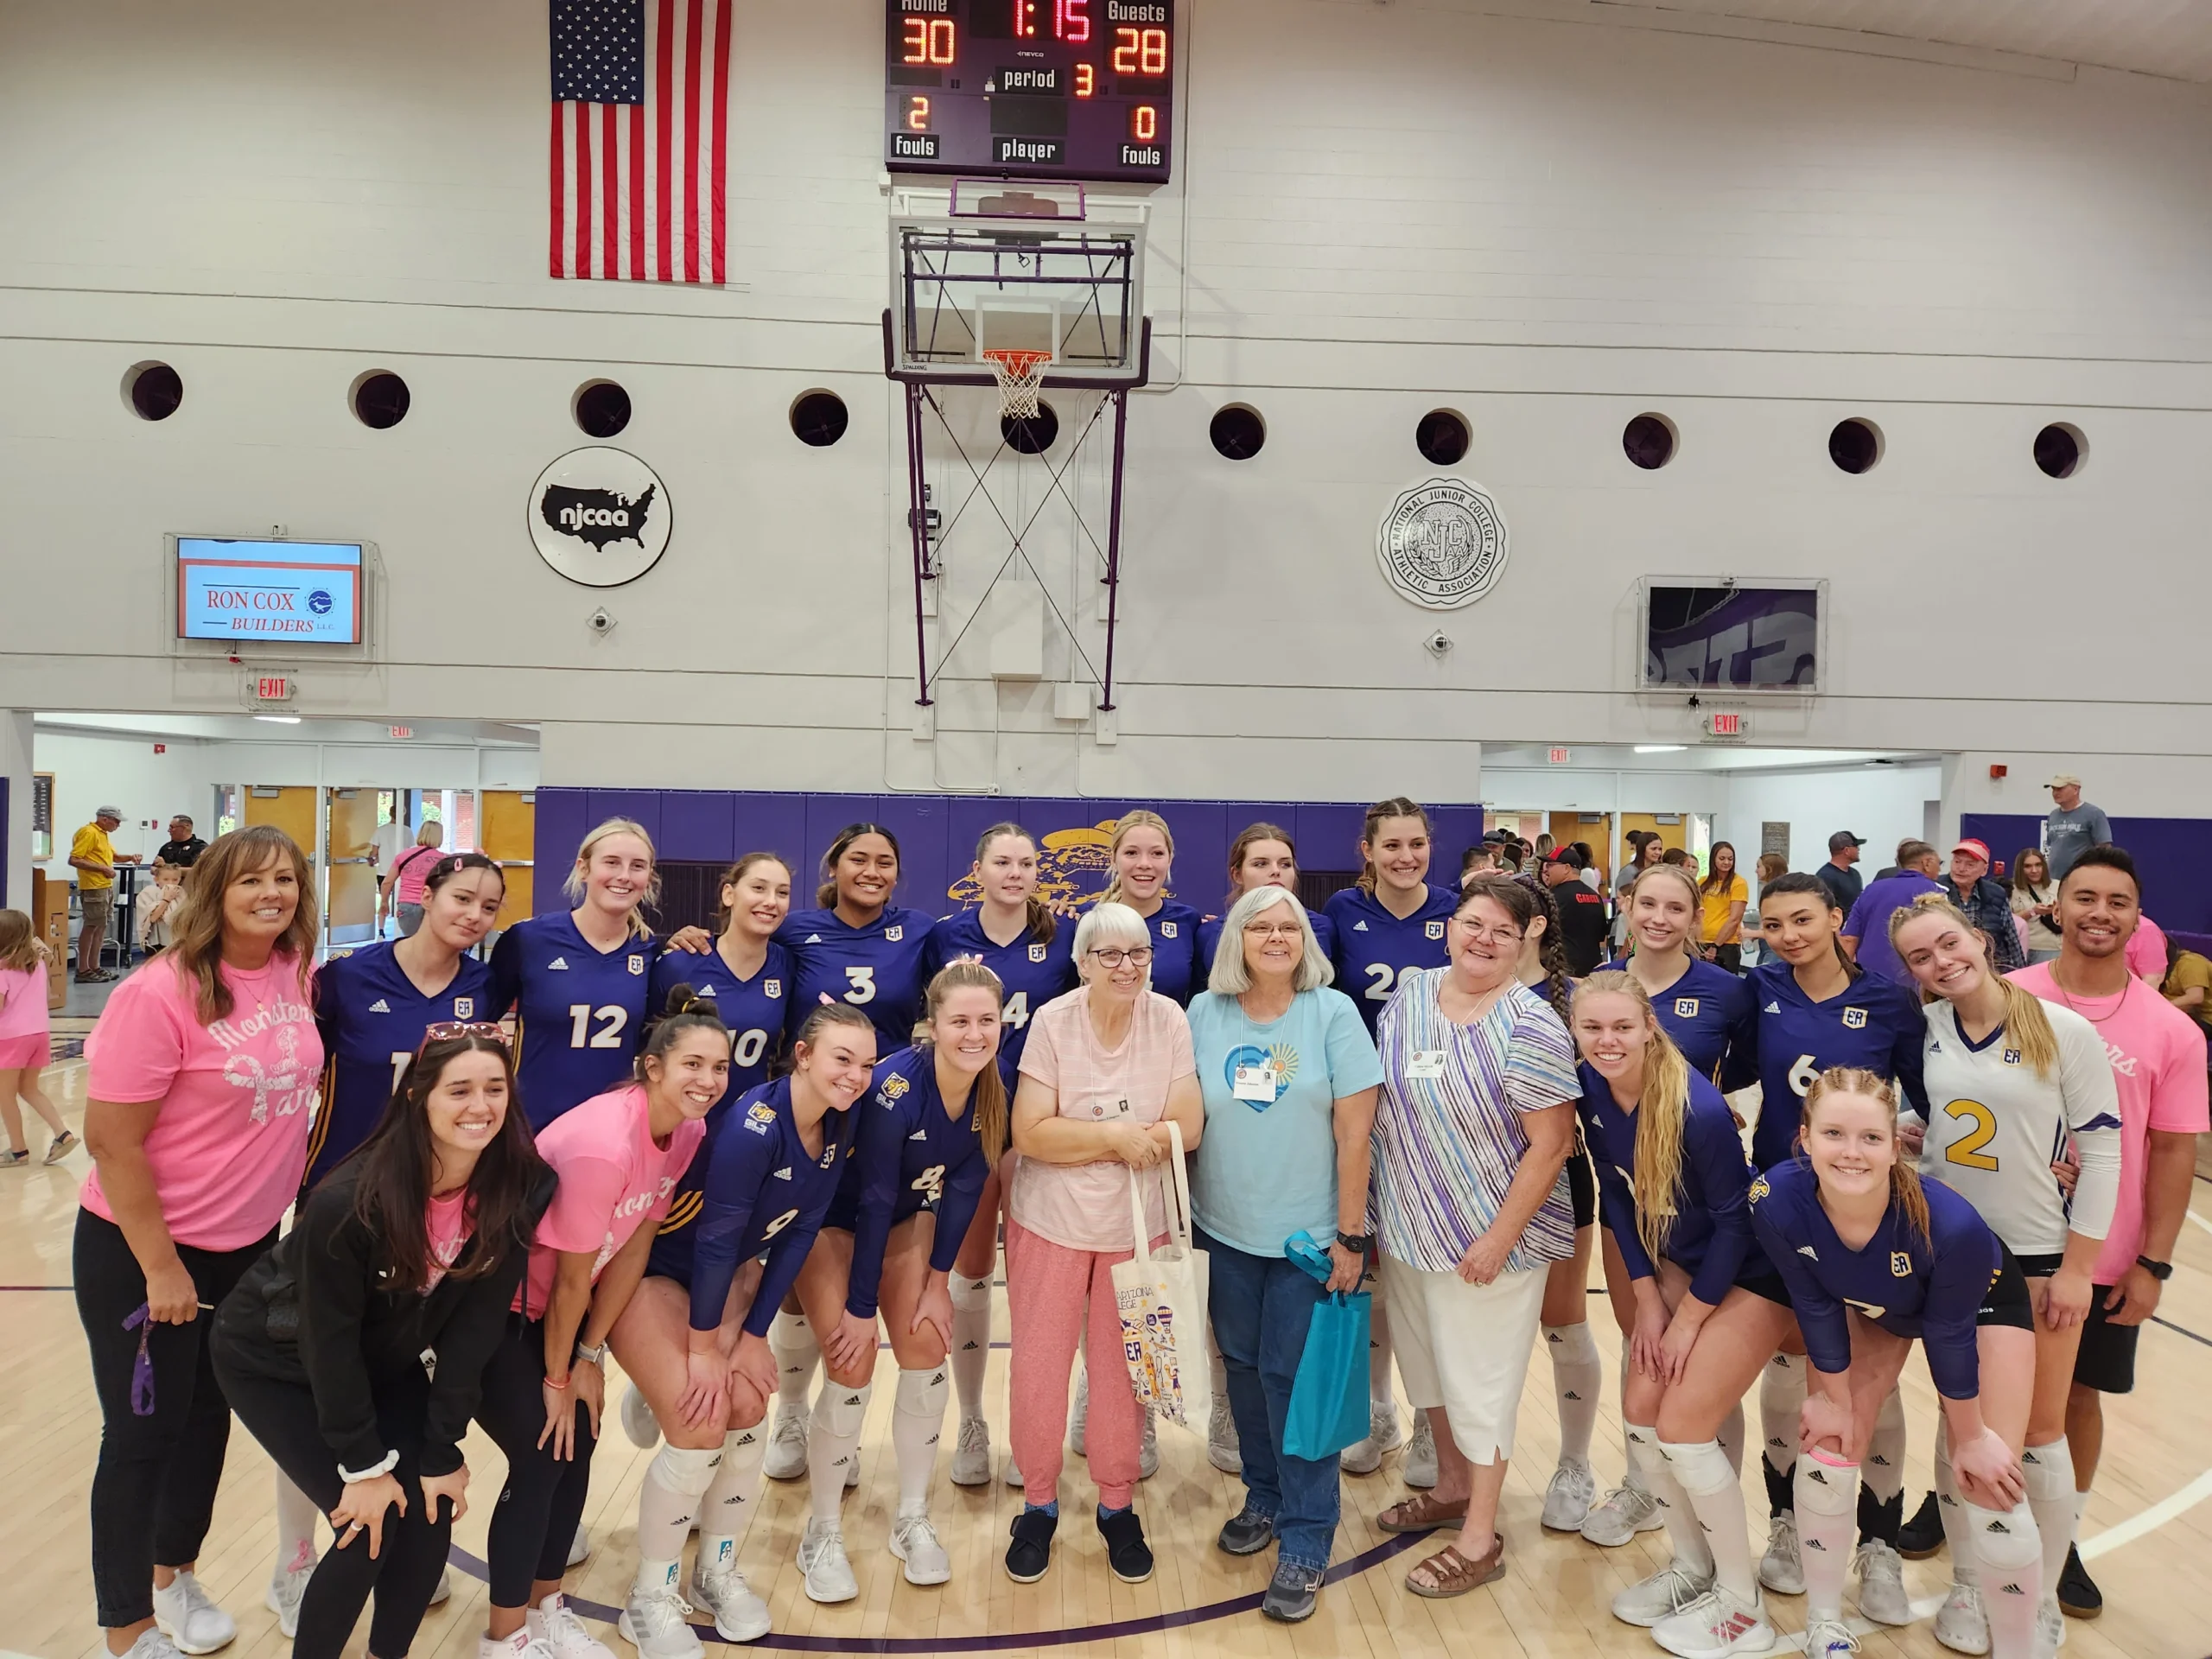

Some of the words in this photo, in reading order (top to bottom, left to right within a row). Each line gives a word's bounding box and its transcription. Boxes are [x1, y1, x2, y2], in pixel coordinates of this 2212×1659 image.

[1015, 0, 1090, 41] 1:15
[1108, 1, 1166, 22] Guests
[904, 18, 955, 65] 30
[1114, 28, 1166, 74] 28
[1004, 69, 1056, 88] period
[1076, 63, 1093, 97] 3
[910, 97, 929, 130] 2
[1136, 106, 1155, 139] 0
[896, 136, 935, 156] fouls
[1001, 141, 1056, 159] player
[1122, 146, 1160, 165] fouls
[560, 503, 629, 531] njcaa
[1392, 496, 1425, 540] NATIONAL
[1429, 490, 1465, 504] JUNIOR
[1468, 500, 1494, 543] COLLEGE
[1392, 549, 1429, 589] ATHLETIC
[1438, 550, 1493, 594] ASSOCIATION
[207, 590, 249, 608] RON
[253, 592, 295, 612] COX
[232, 617, 314, 632] BUILDERS
[259, 678, 285, 698] EXIT
[392, 725, 410, 737] EXIT
[1714, 714, 1738, 733] EXIT
[1551, 749, 1567, 762] EXIT
[1428, 924, 1441, 938] EA
[842, 966, 877, 1005] 3
[1001, 991, 1030, 1029] 4
[1678, 1001, 1695, 1015] EA
[1846, 1010, 1864, 1026] EA
[569, 1004, 629, 1049] 12
[2004, 1047, 2022, 1065] EA
[1788, 1053, 1821, 1097] 6
[1942, 1098, 1999, 1173] 2
[760, 1209, 799, 1242] 9
[1116, 1287, 1154, 1301] ARIZONA
